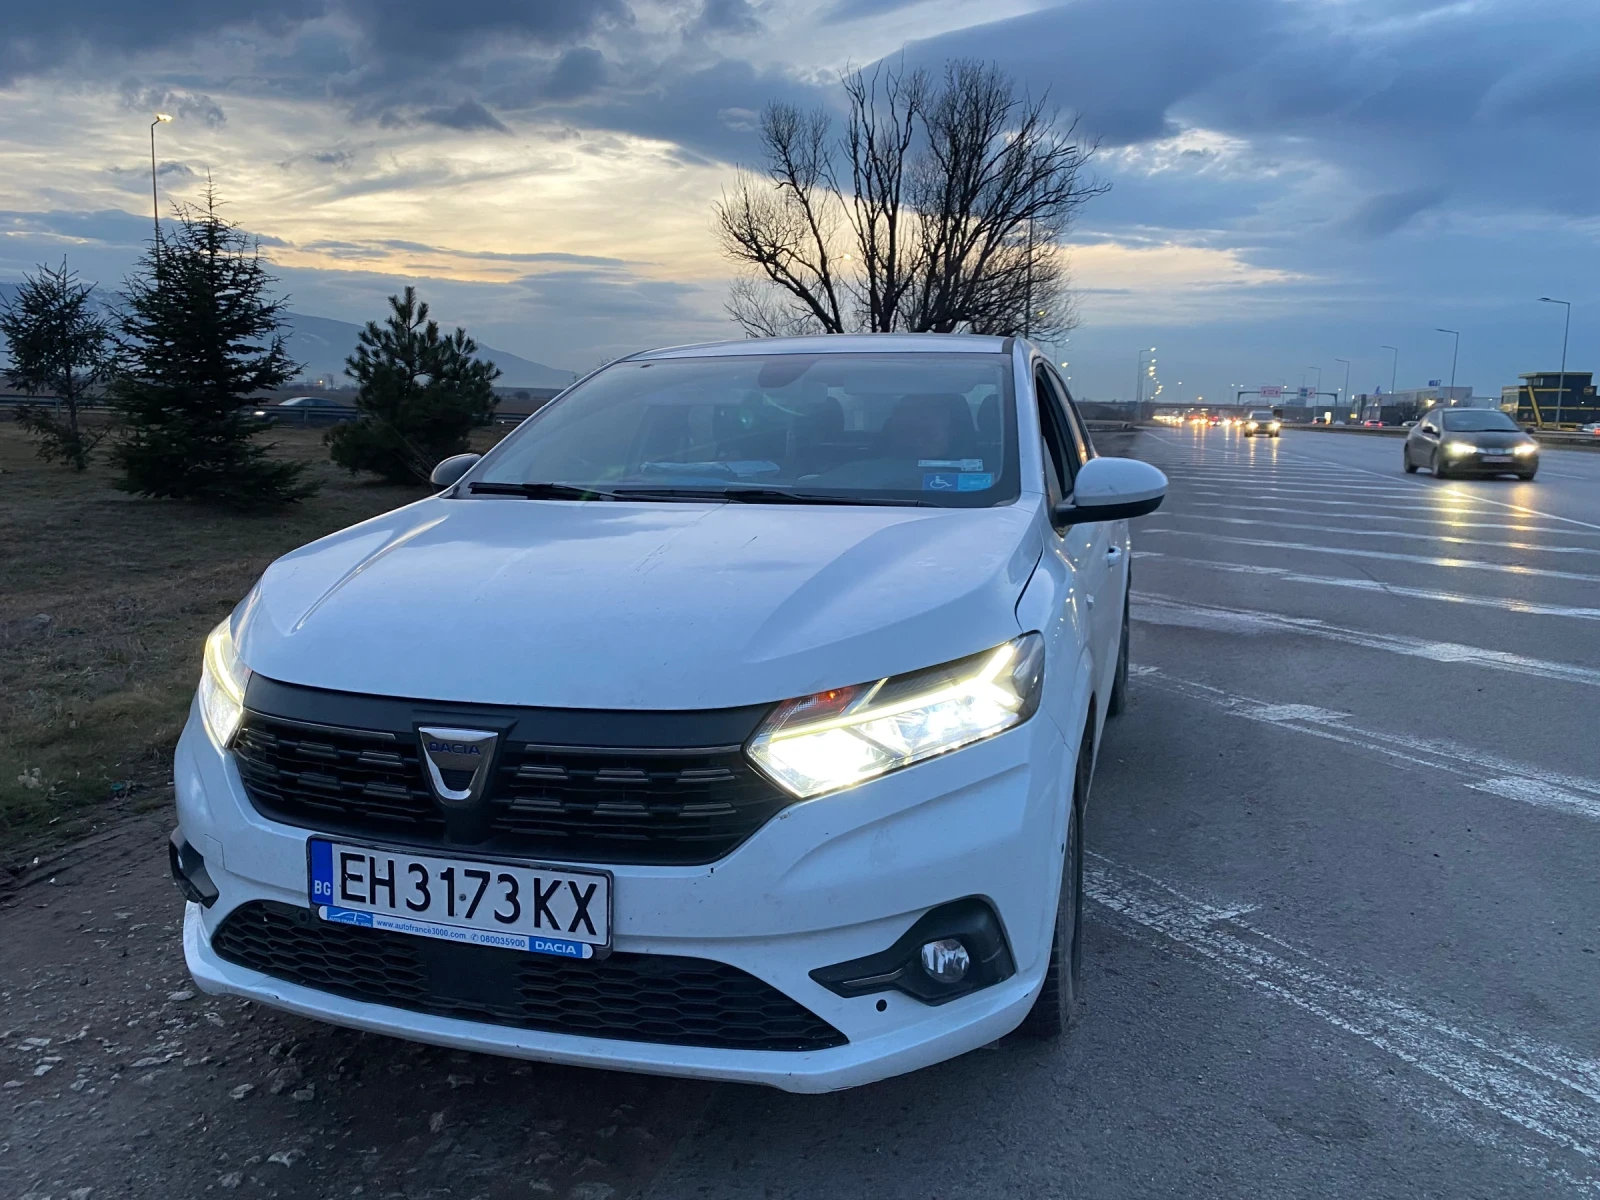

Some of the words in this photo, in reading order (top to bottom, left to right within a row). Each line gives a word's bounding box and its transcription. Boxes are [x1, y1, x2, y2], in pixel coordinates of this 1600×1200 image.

[429, 742, 481, 755] DACIA
[314, 879, 331, 896] BG
[376, 919, 467, 940] www.autofrance3000.com
[480, 934, 526, 948] 080035900
[535, 940, 577, 955] DACIA
